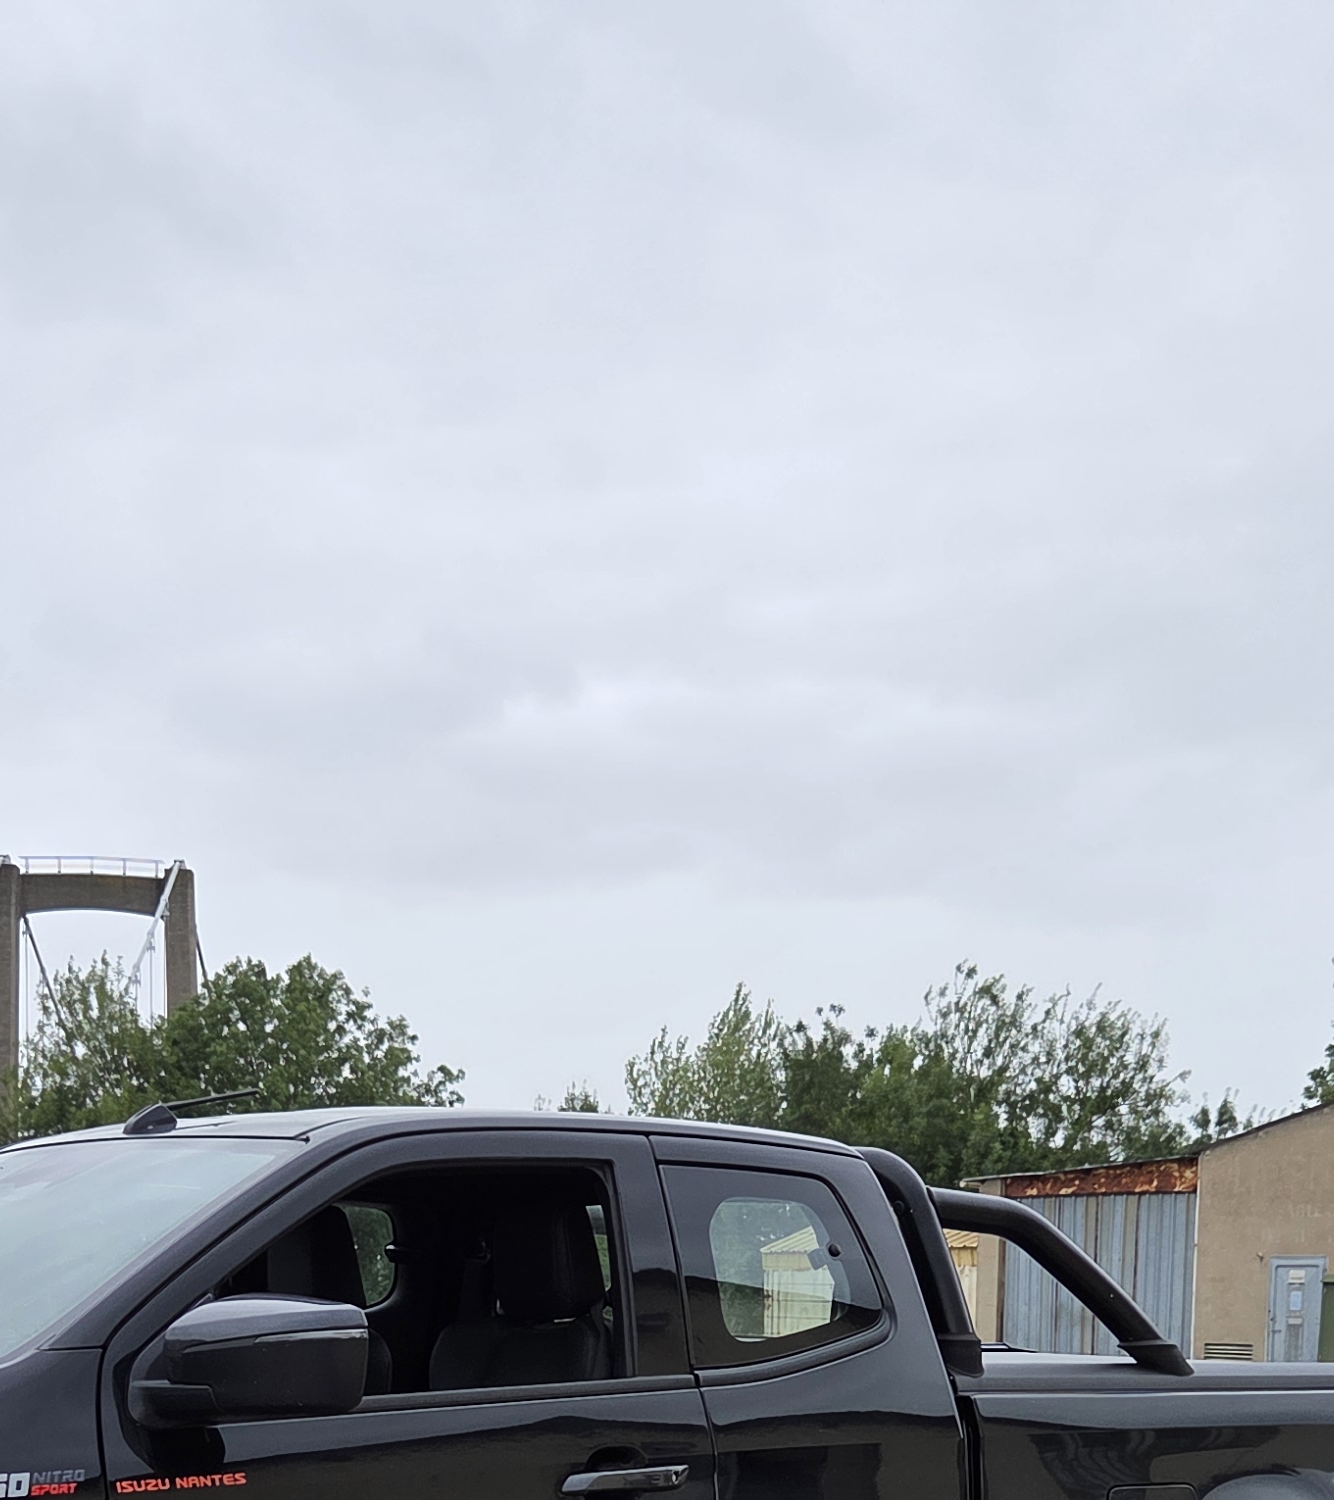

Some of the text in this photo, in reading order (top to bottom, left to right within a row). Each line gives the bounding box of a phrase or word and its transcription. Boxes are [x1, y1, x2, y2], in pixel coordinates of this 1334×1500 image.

[32, 1469, 86, 1484] NITRO
[116, 1472, 247, 1494] ISUZU NANTES
[30, 1483, 78, 1497] SPORT
